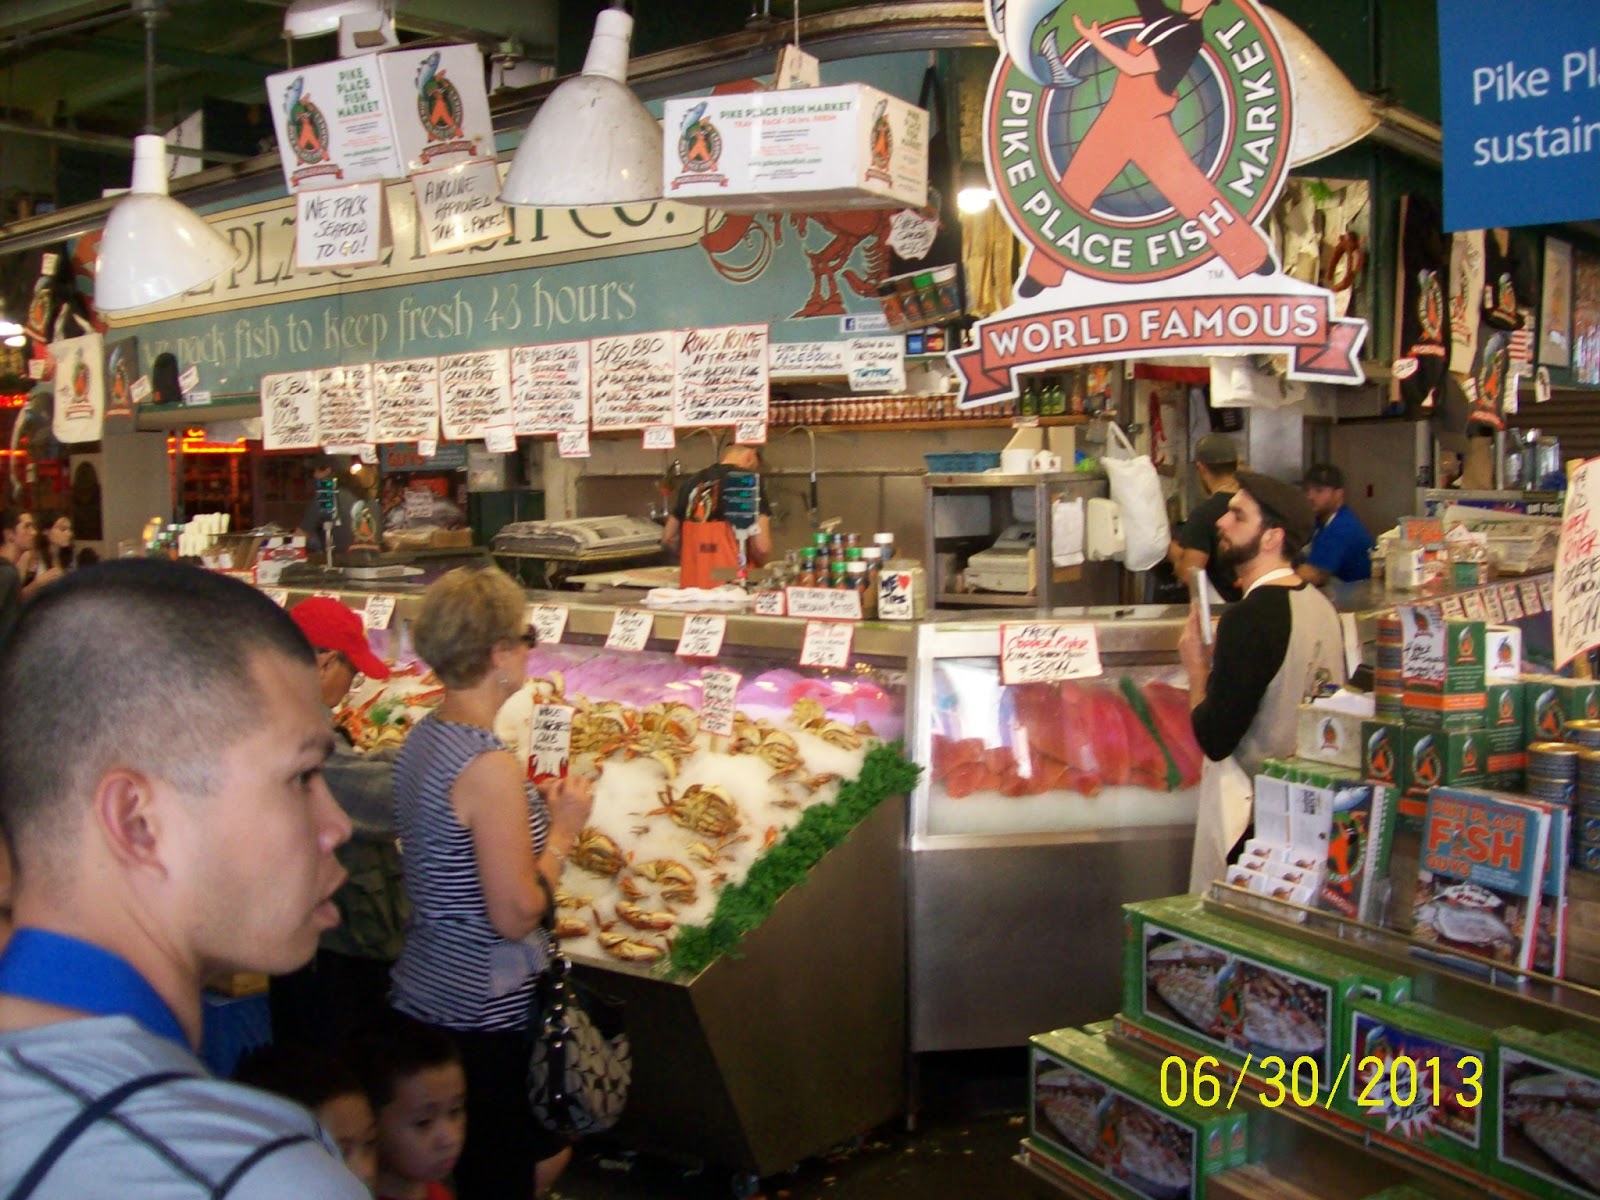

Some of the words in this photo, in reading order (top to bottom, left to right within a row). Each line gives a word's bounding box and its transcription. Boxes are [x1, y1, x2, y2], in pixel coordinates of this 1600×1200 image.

[336, 78, 371, 95] PLACE
[339, 67, 364, 81] PIKE
[1473, 61, 1550, 105] Pike
[1563, 47, 1600, 92] Pl
[336, 101, 379, 118] MARKET
[343, 90, 368, 105] FISH
[719, 109, 743, 119] PIKE
[781, 104, 803, 114] FISH
[806, 102, 852, 113] MARKET
[1001, 89, 1037, 187] PIKE
[1022, 190, 1132, 269] PLACE
[1146, 199, 1235, 267] FISH
[1213, 18, 1278, 199] MARKET
[425, 176, 477, 204] AIRLINE
[305, 199, 328, 221] WE
[332, 195, 369, 219] PACK
[313, 218, 368, 239] SEAFOOD
[317, 244, 337, 260] TO
[340, 235, 368, 257] GO!
[1209, 270, 1224, 279] TM
[176, 324, 226, 368] pack
[234, 318, 280, 370] fish
[287, 312, 313, 352] to
[323, 305, 389, 357] keep
[397, 289, 474, 353] fresh
[532, 276, 637, 330] hours
[988, 312, 1129, 357] WORLD
[1140, 304, 1318, 342] FAMOUS
[723, 328, 766, 349] ROYCE
[595, 338, 631, 368] 50/50
[1471, 808, 1526, 832] PLACE
[1427, 817, 1525, 873] FISH
[1425, 853, 1472, 878] GUYS
